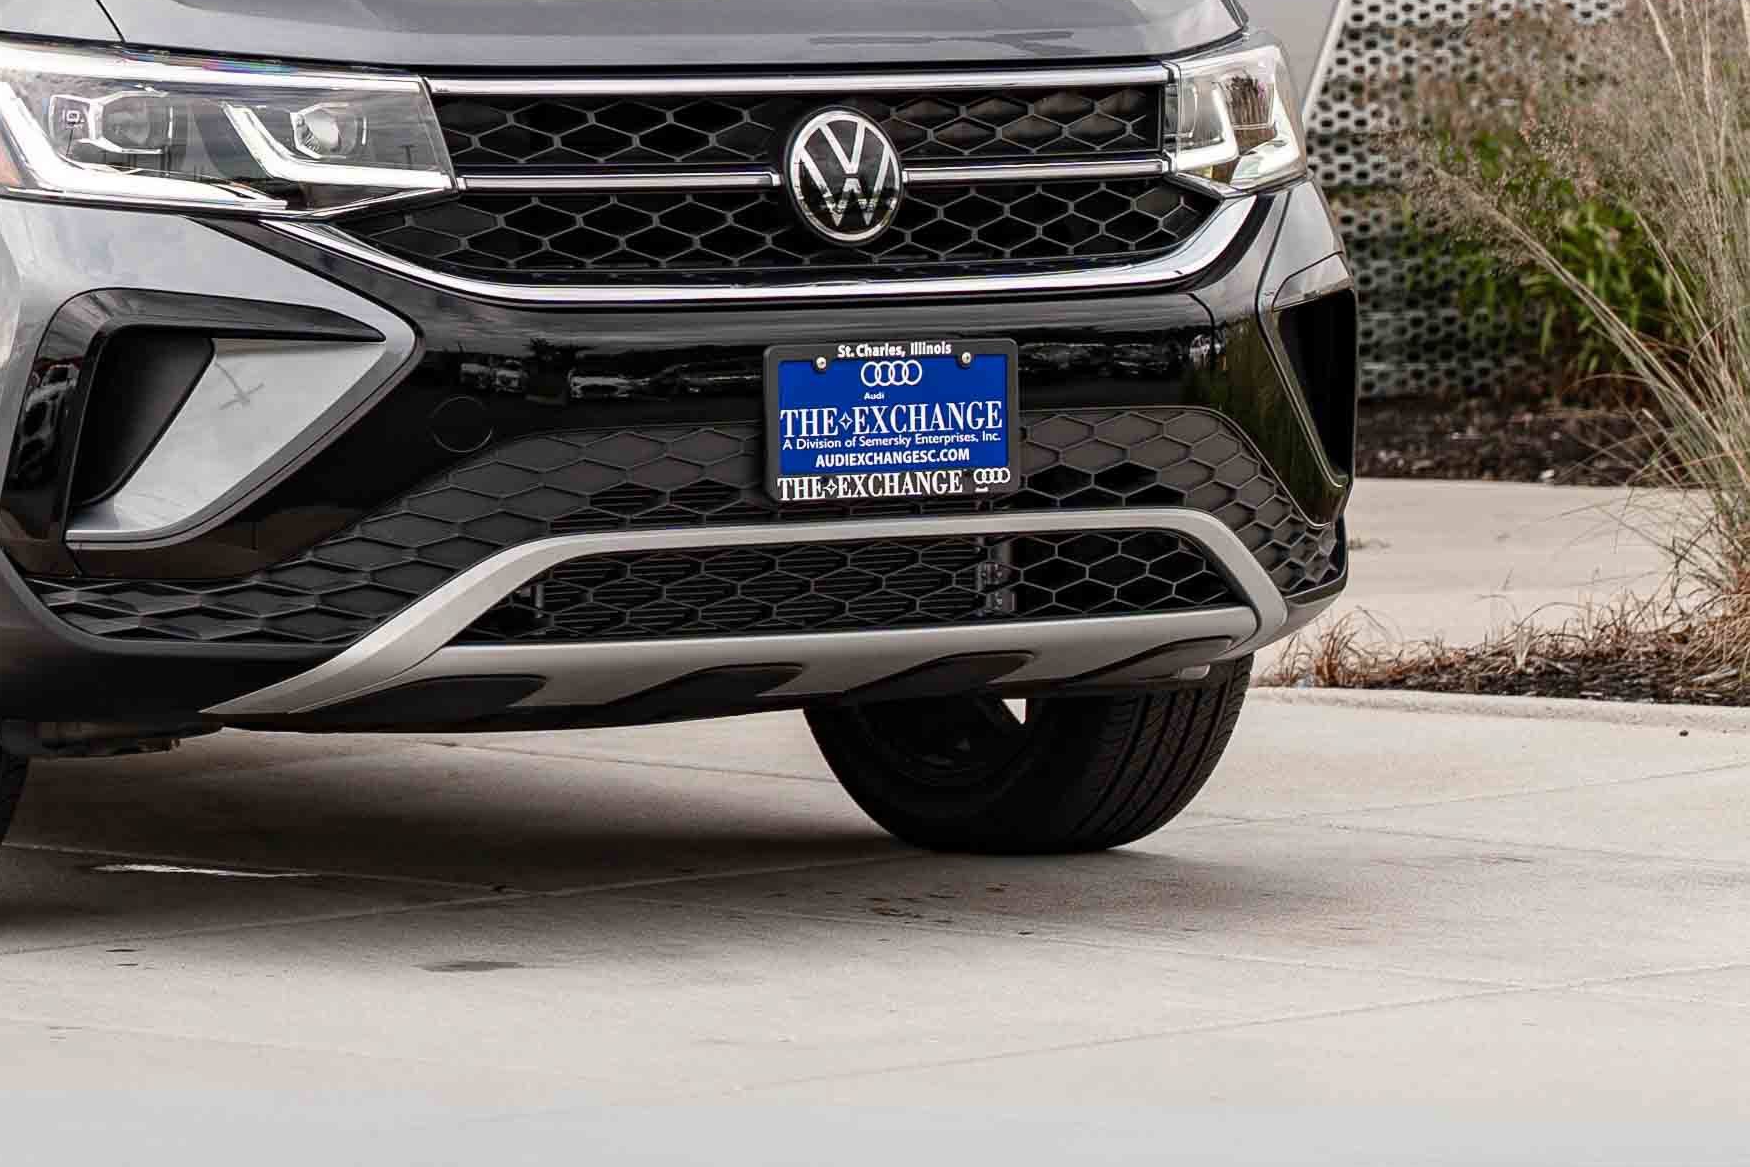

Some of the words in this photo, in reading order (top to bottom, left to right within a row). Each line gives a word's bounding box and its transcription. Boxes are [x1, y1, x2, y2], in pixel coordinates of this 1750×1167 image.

[837, 344, 855, 358] St.
[856, 342, 906, 357] Charles,
[910, 341, 952, 355] Illinois
[864, 392, 885, 400] Audi
[780, 408, 839, 438] THE
[852, 400, 1003, 435] EXCHANGE
[782, 438, 793, 451] A
[796, 437, 842, 450] Division
[844, 435, 857, 448] of
[858, 433, 912, 448] Semersky
[915, 432, 979, 446] Enterprises,
[982, 430, 1002, 442] Inc.
[815, 448, 970, 468] AUDIEXCHANGESC.COM
[777, 476, 826, 501] THE
[836, 469, 963, 499] EXCHANGE
